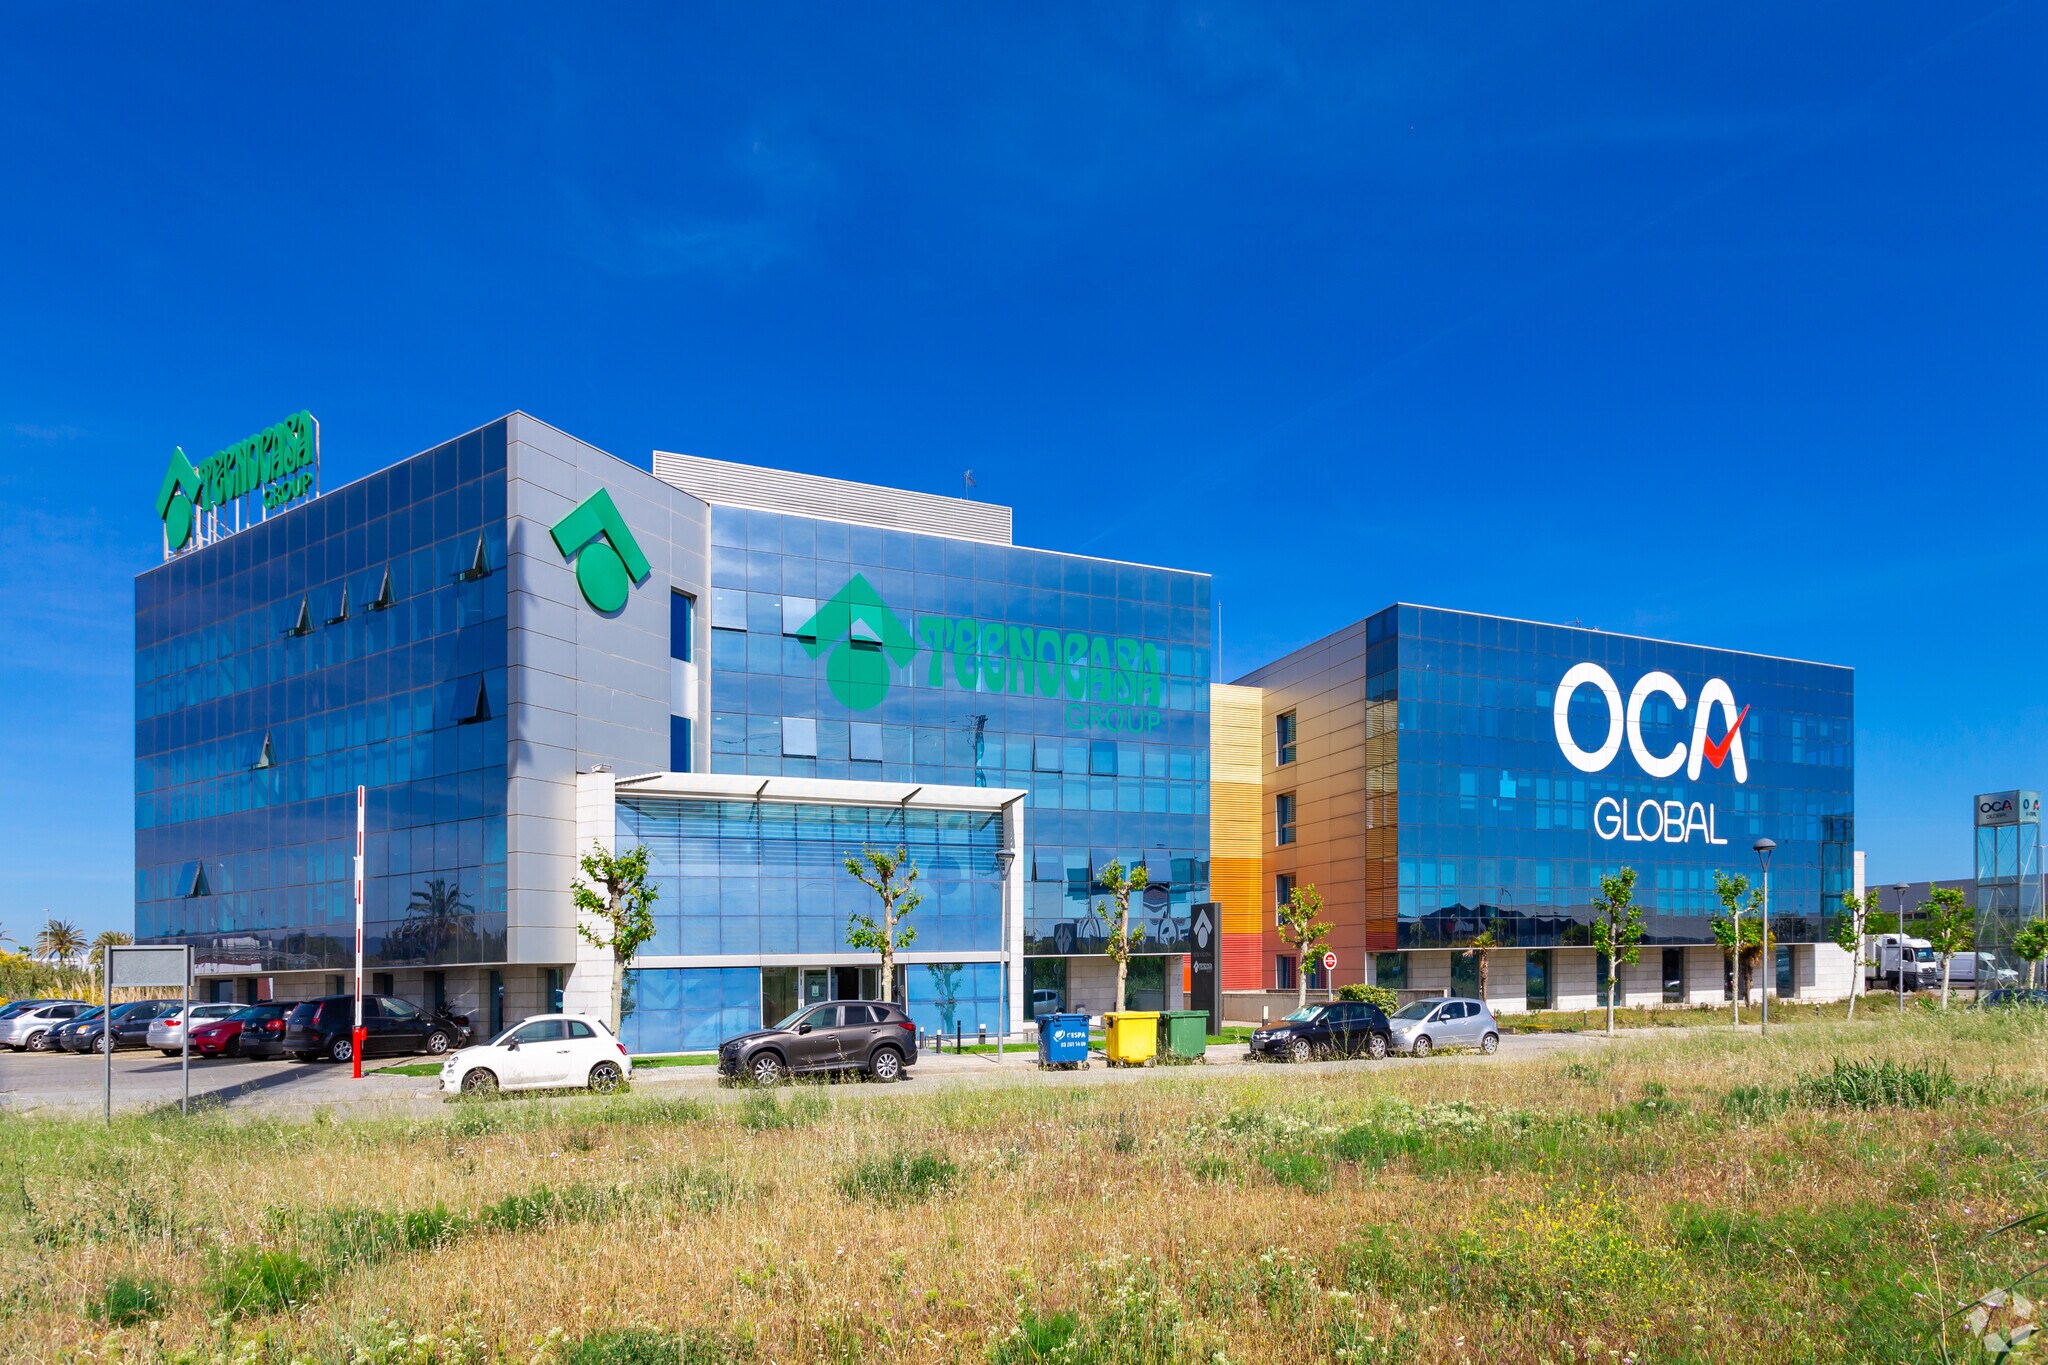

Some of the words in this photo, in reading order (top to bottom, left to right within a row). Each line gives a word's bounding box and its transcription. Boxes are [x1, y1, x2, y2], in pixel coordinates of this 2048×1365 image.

[200, 409, 313, 512] TECNOCASA
[263, 472, 313, 510] GROUP
[919, 616, 1161, 707] TECNOCASA
[1065, 703, 1162, 735] GROUP
[1553, 662, 1749, 784] OCA
[1593, 796, 1728, 845] GLOBAL
[1980, 799, 2013, 814] OCA
